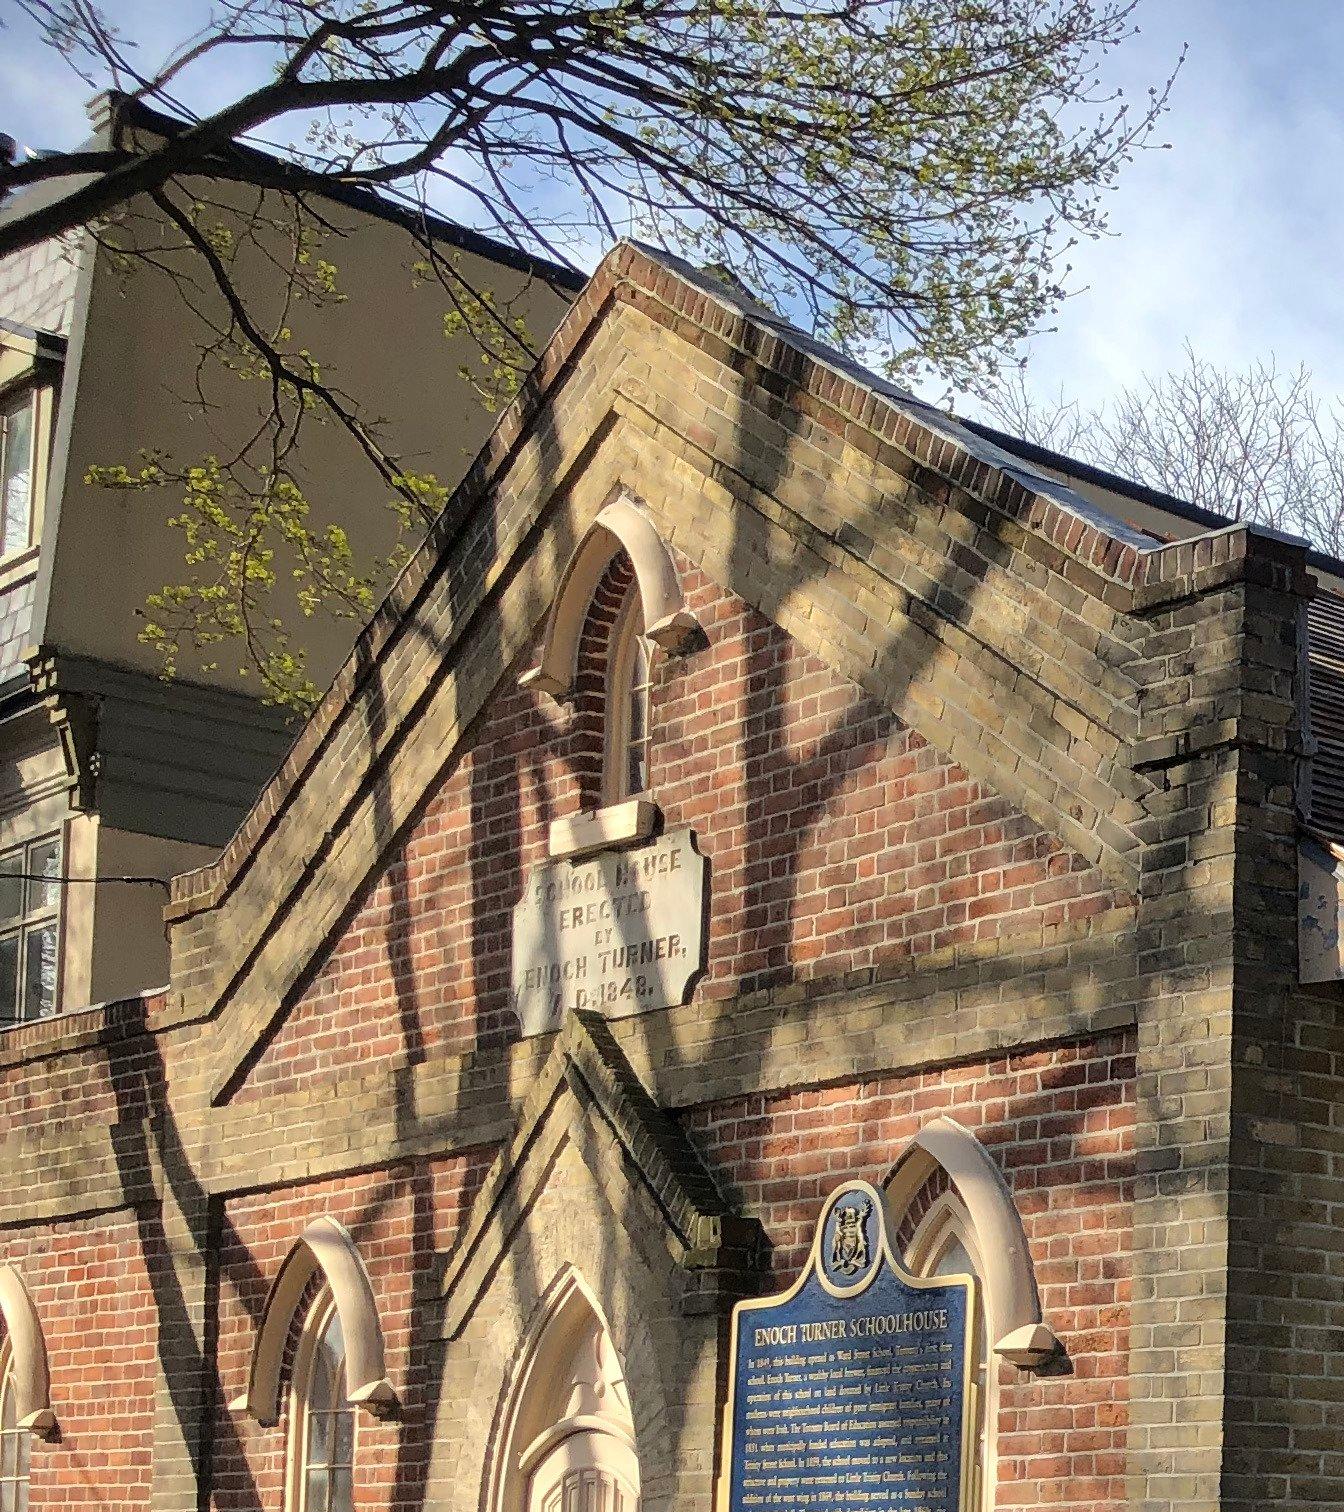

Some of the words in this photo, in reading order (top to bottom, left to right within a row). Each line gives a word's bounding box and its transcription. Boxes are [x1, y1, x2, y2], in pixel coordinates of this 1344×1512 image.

[560, 890, 651, 933] ERECTED
[755, 1325, 797, 1347] ENOCH
[800, 1320, 846, 1342] TURNER
[850, 1309, 948, 1337] SCHOOLHOUSE
